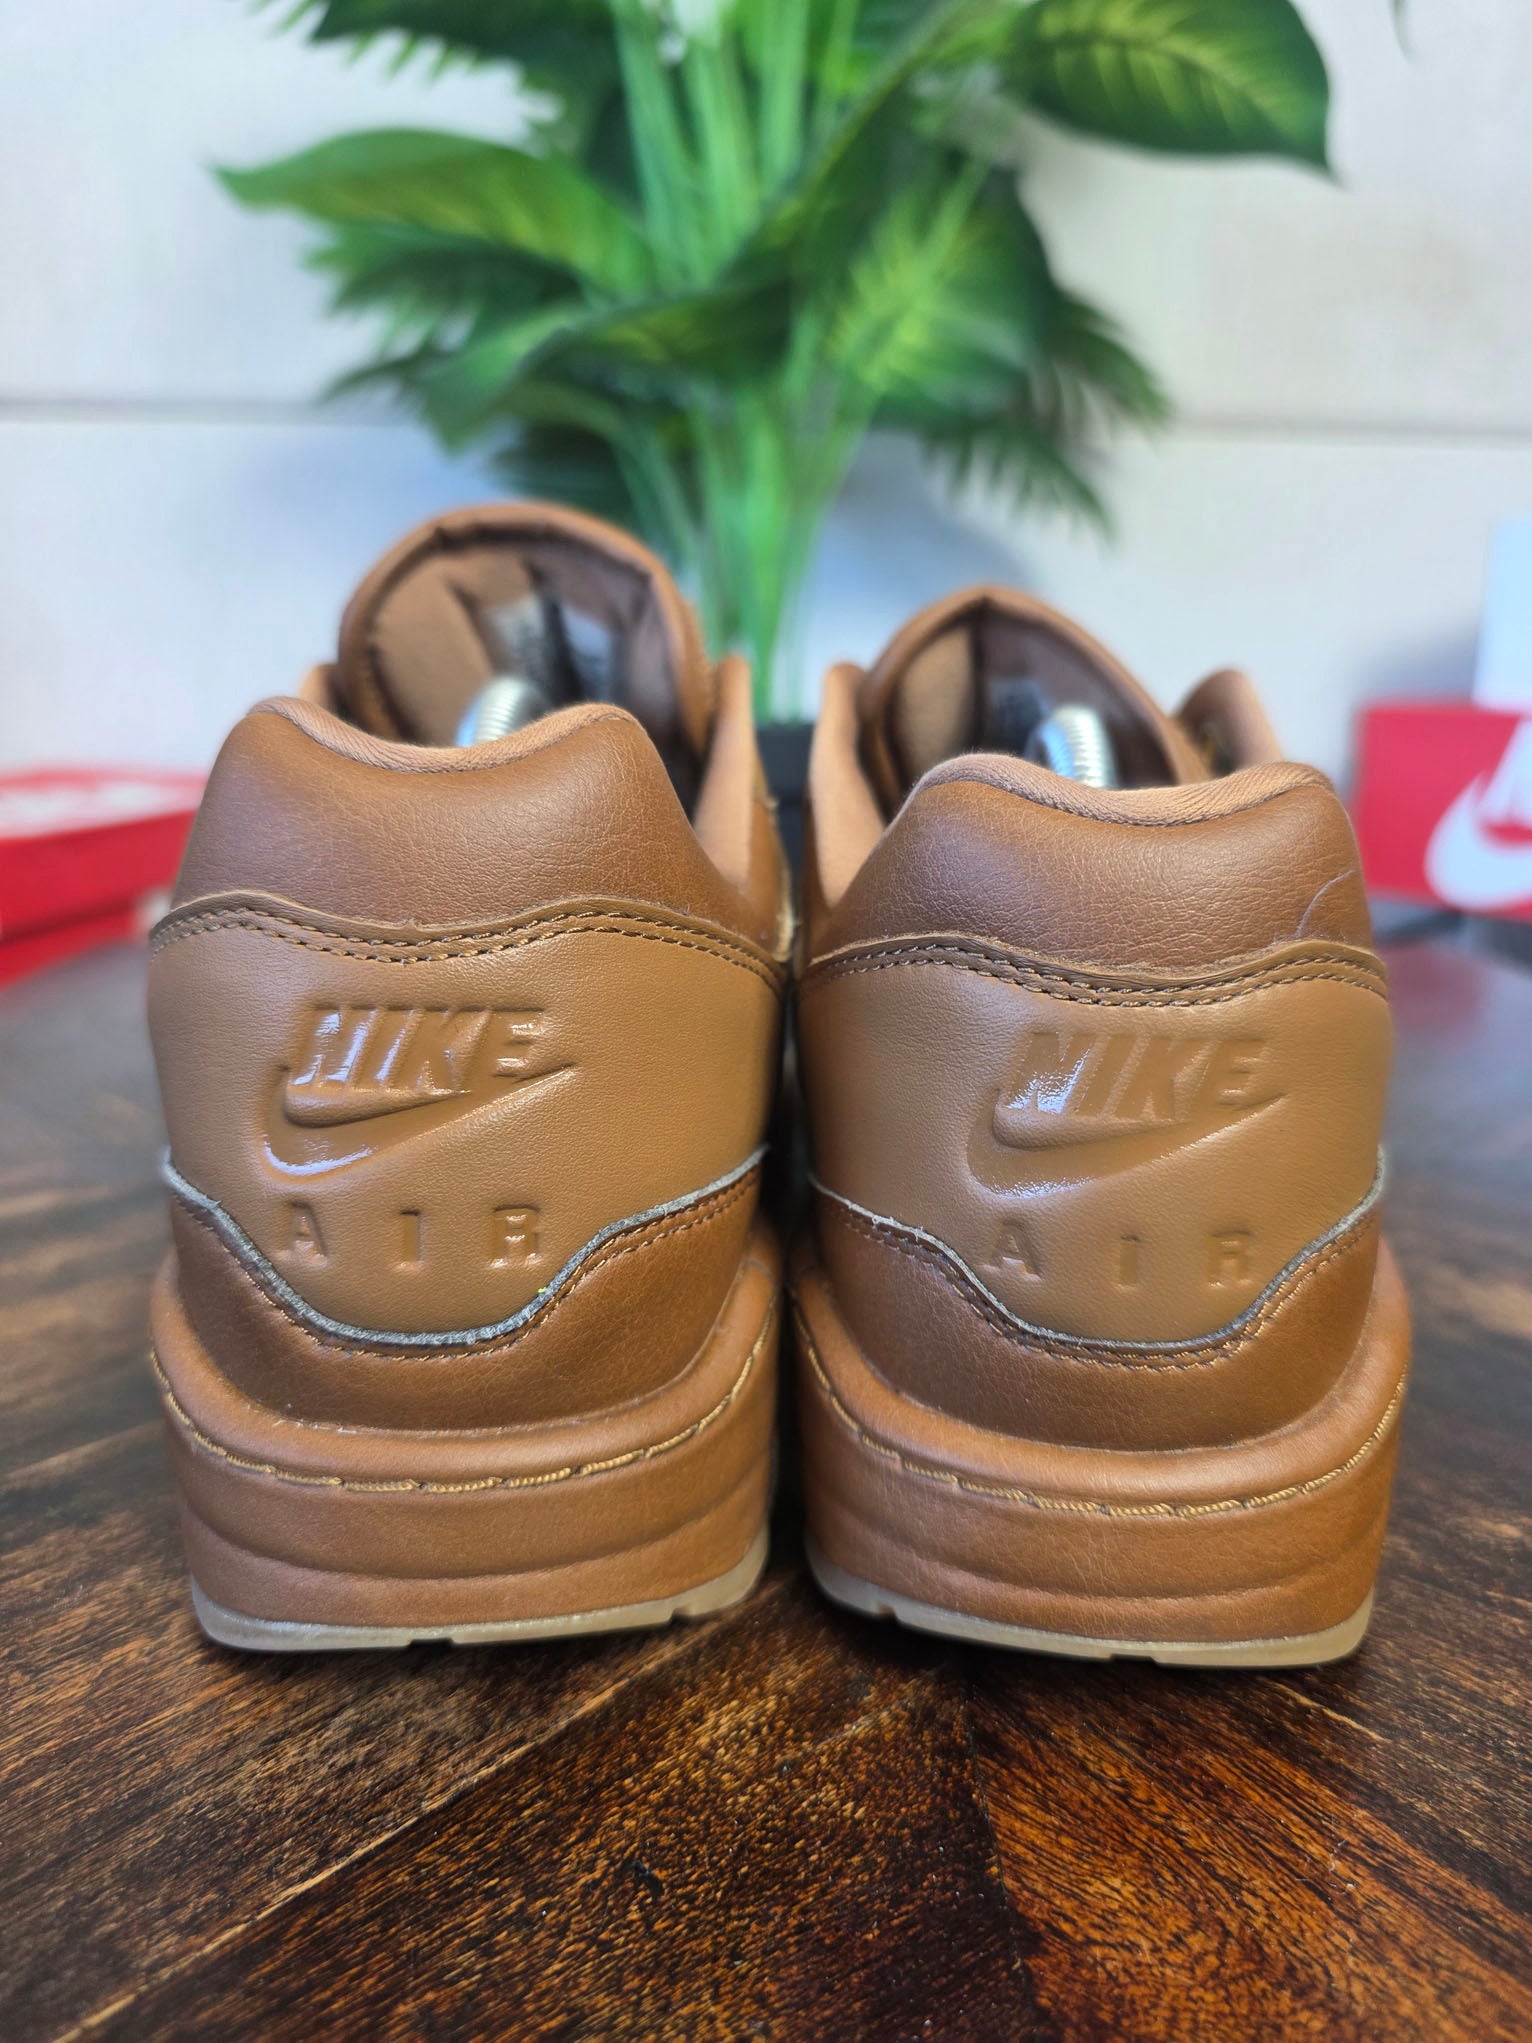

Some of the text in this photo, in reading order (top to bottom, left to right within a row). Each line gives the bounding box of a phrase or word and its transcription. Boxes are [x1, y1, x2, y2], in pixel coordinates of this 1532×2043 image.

[290, 1003, 546, 1092] NIKE
[1003, 1030, 1268, 1122] NIKE
[272, 1199, 545, 1271] AIR
[975, 1218, 1256, 1291] AIR
